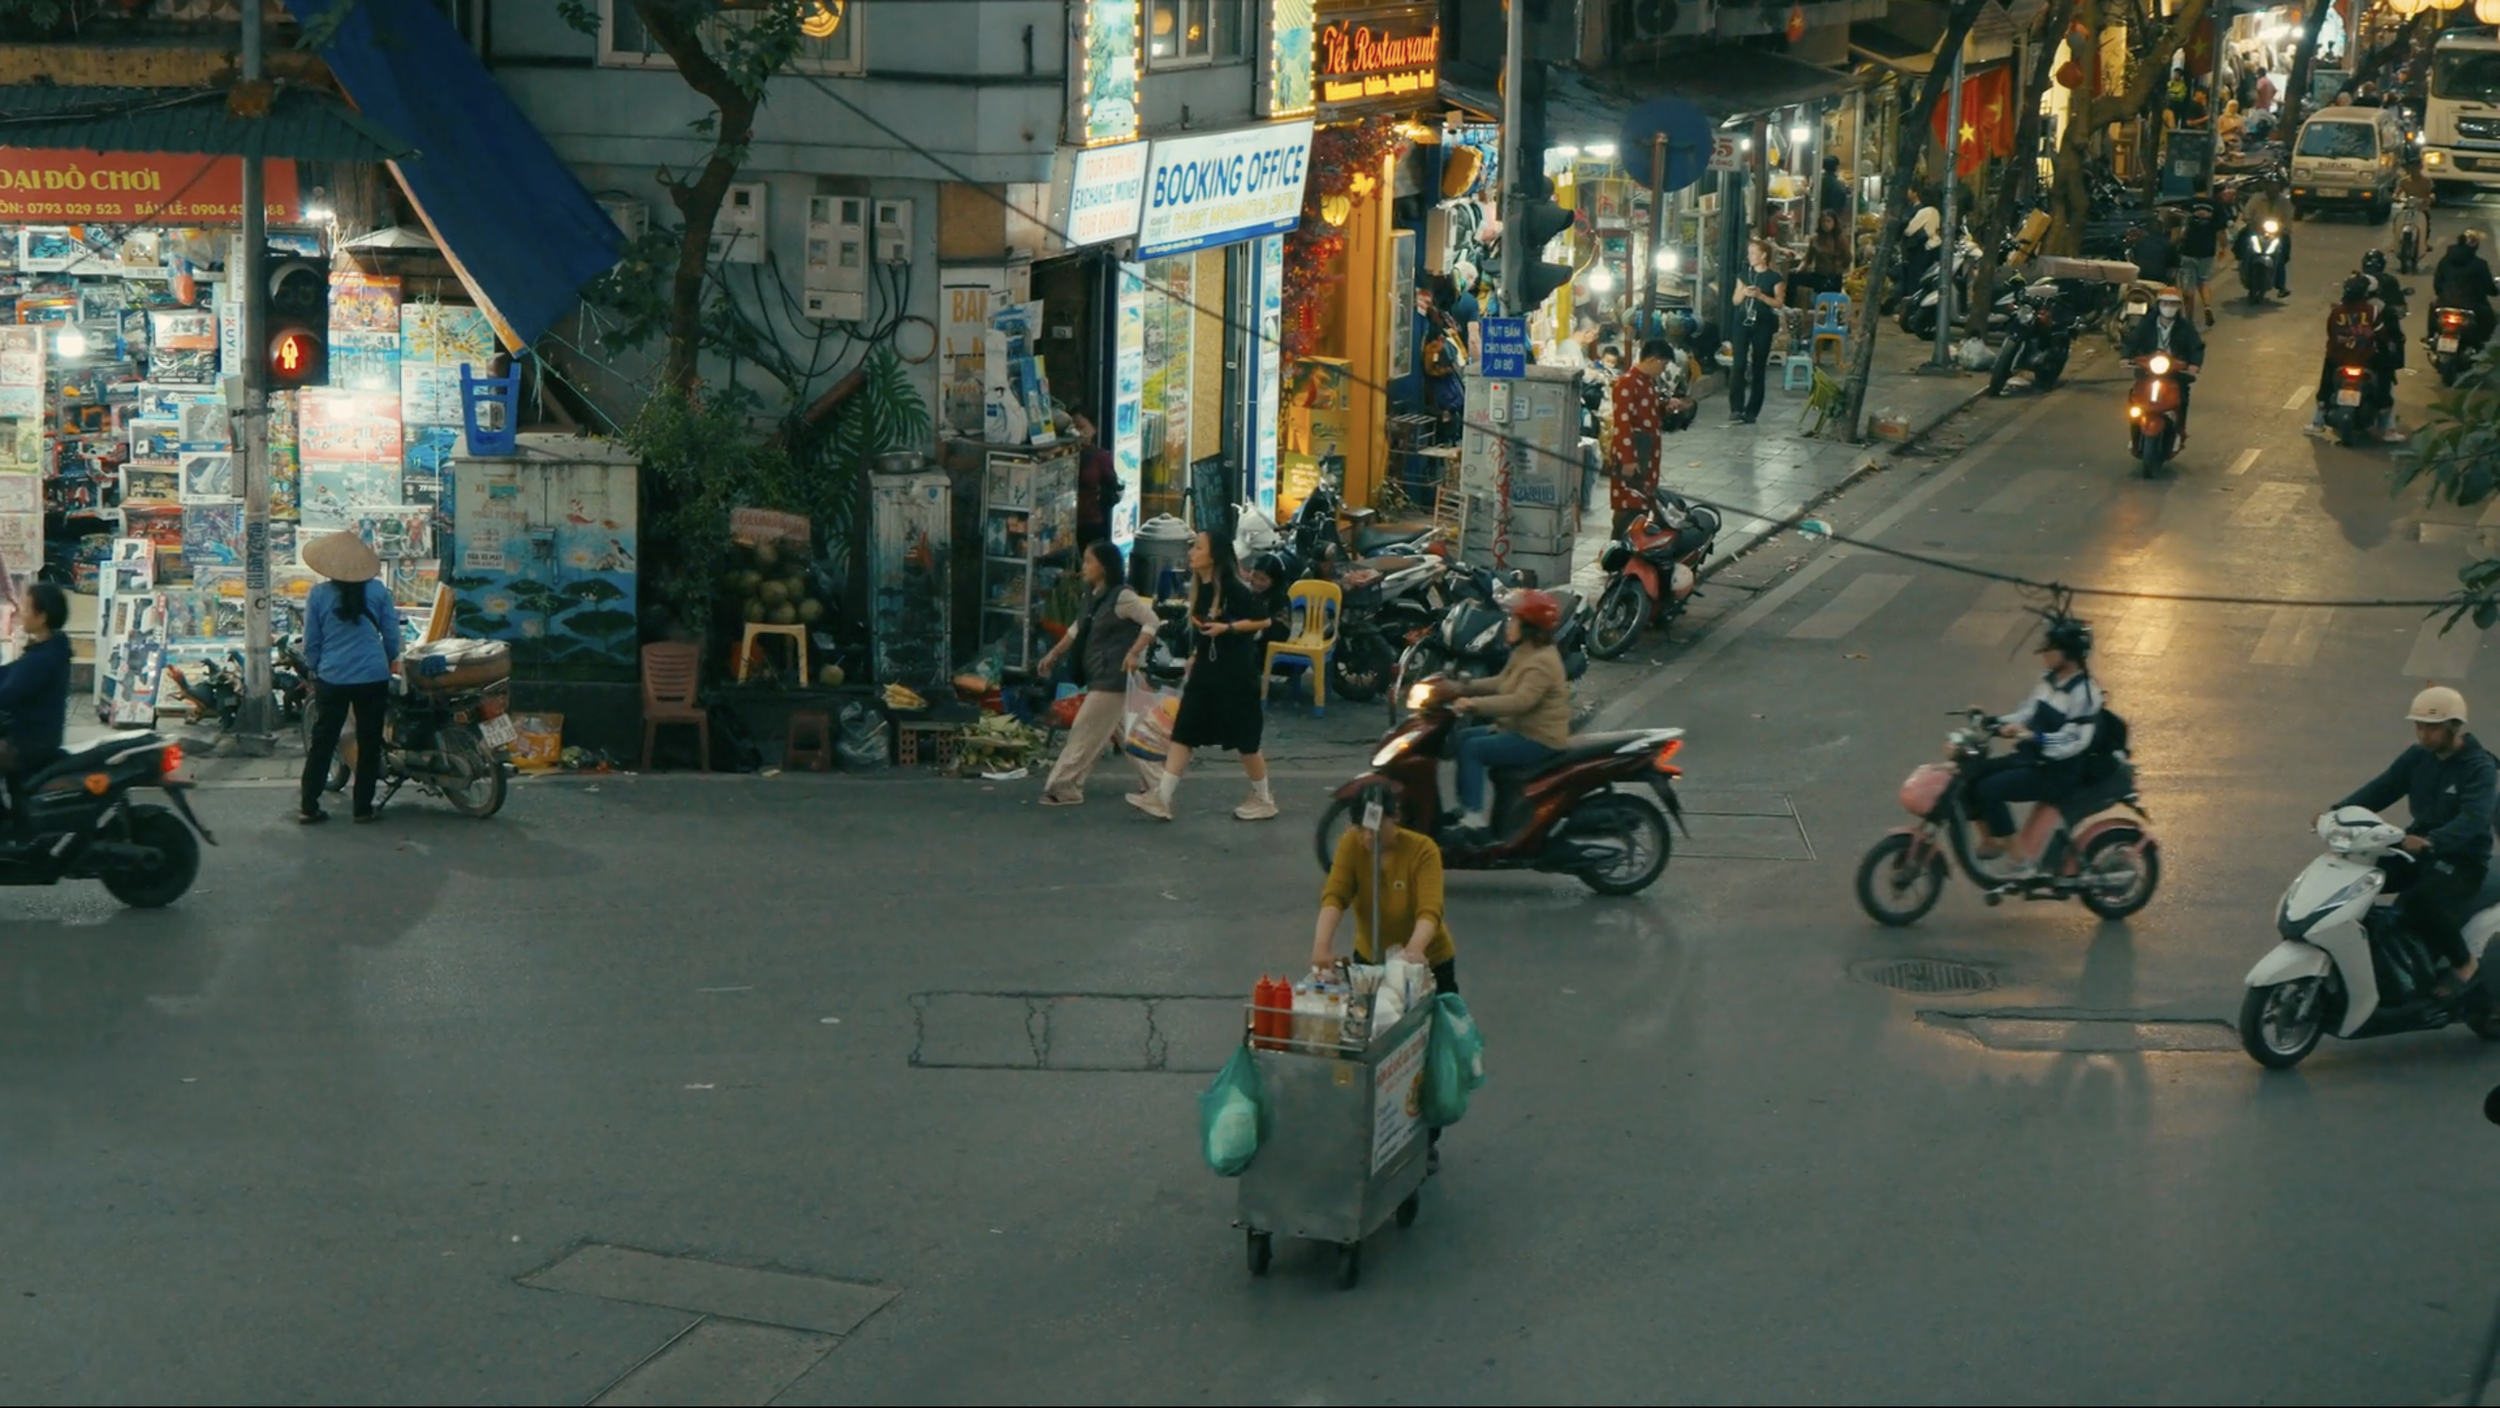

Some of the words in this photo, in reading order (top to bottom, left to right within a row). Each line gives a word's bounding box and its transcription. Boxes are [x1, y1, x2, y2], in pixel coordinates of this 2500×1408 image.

[1353, 23, 1439, 72] Restaurant
[2318, 161, 2352, 169] SUZUKI
[44, 163, 86, 190] ĐỒ
[90, 168, 161, 190] CHƠI
[1153, 154, 1244, 208] BOOKING
[1247, 145, 1304, 193] OFFICE
[27, 203, 62, 214] 0793
[66, 203, 92, 214] 029
[96, 204, 122, 215] 523
[191, 204, 226, 215] 0904
